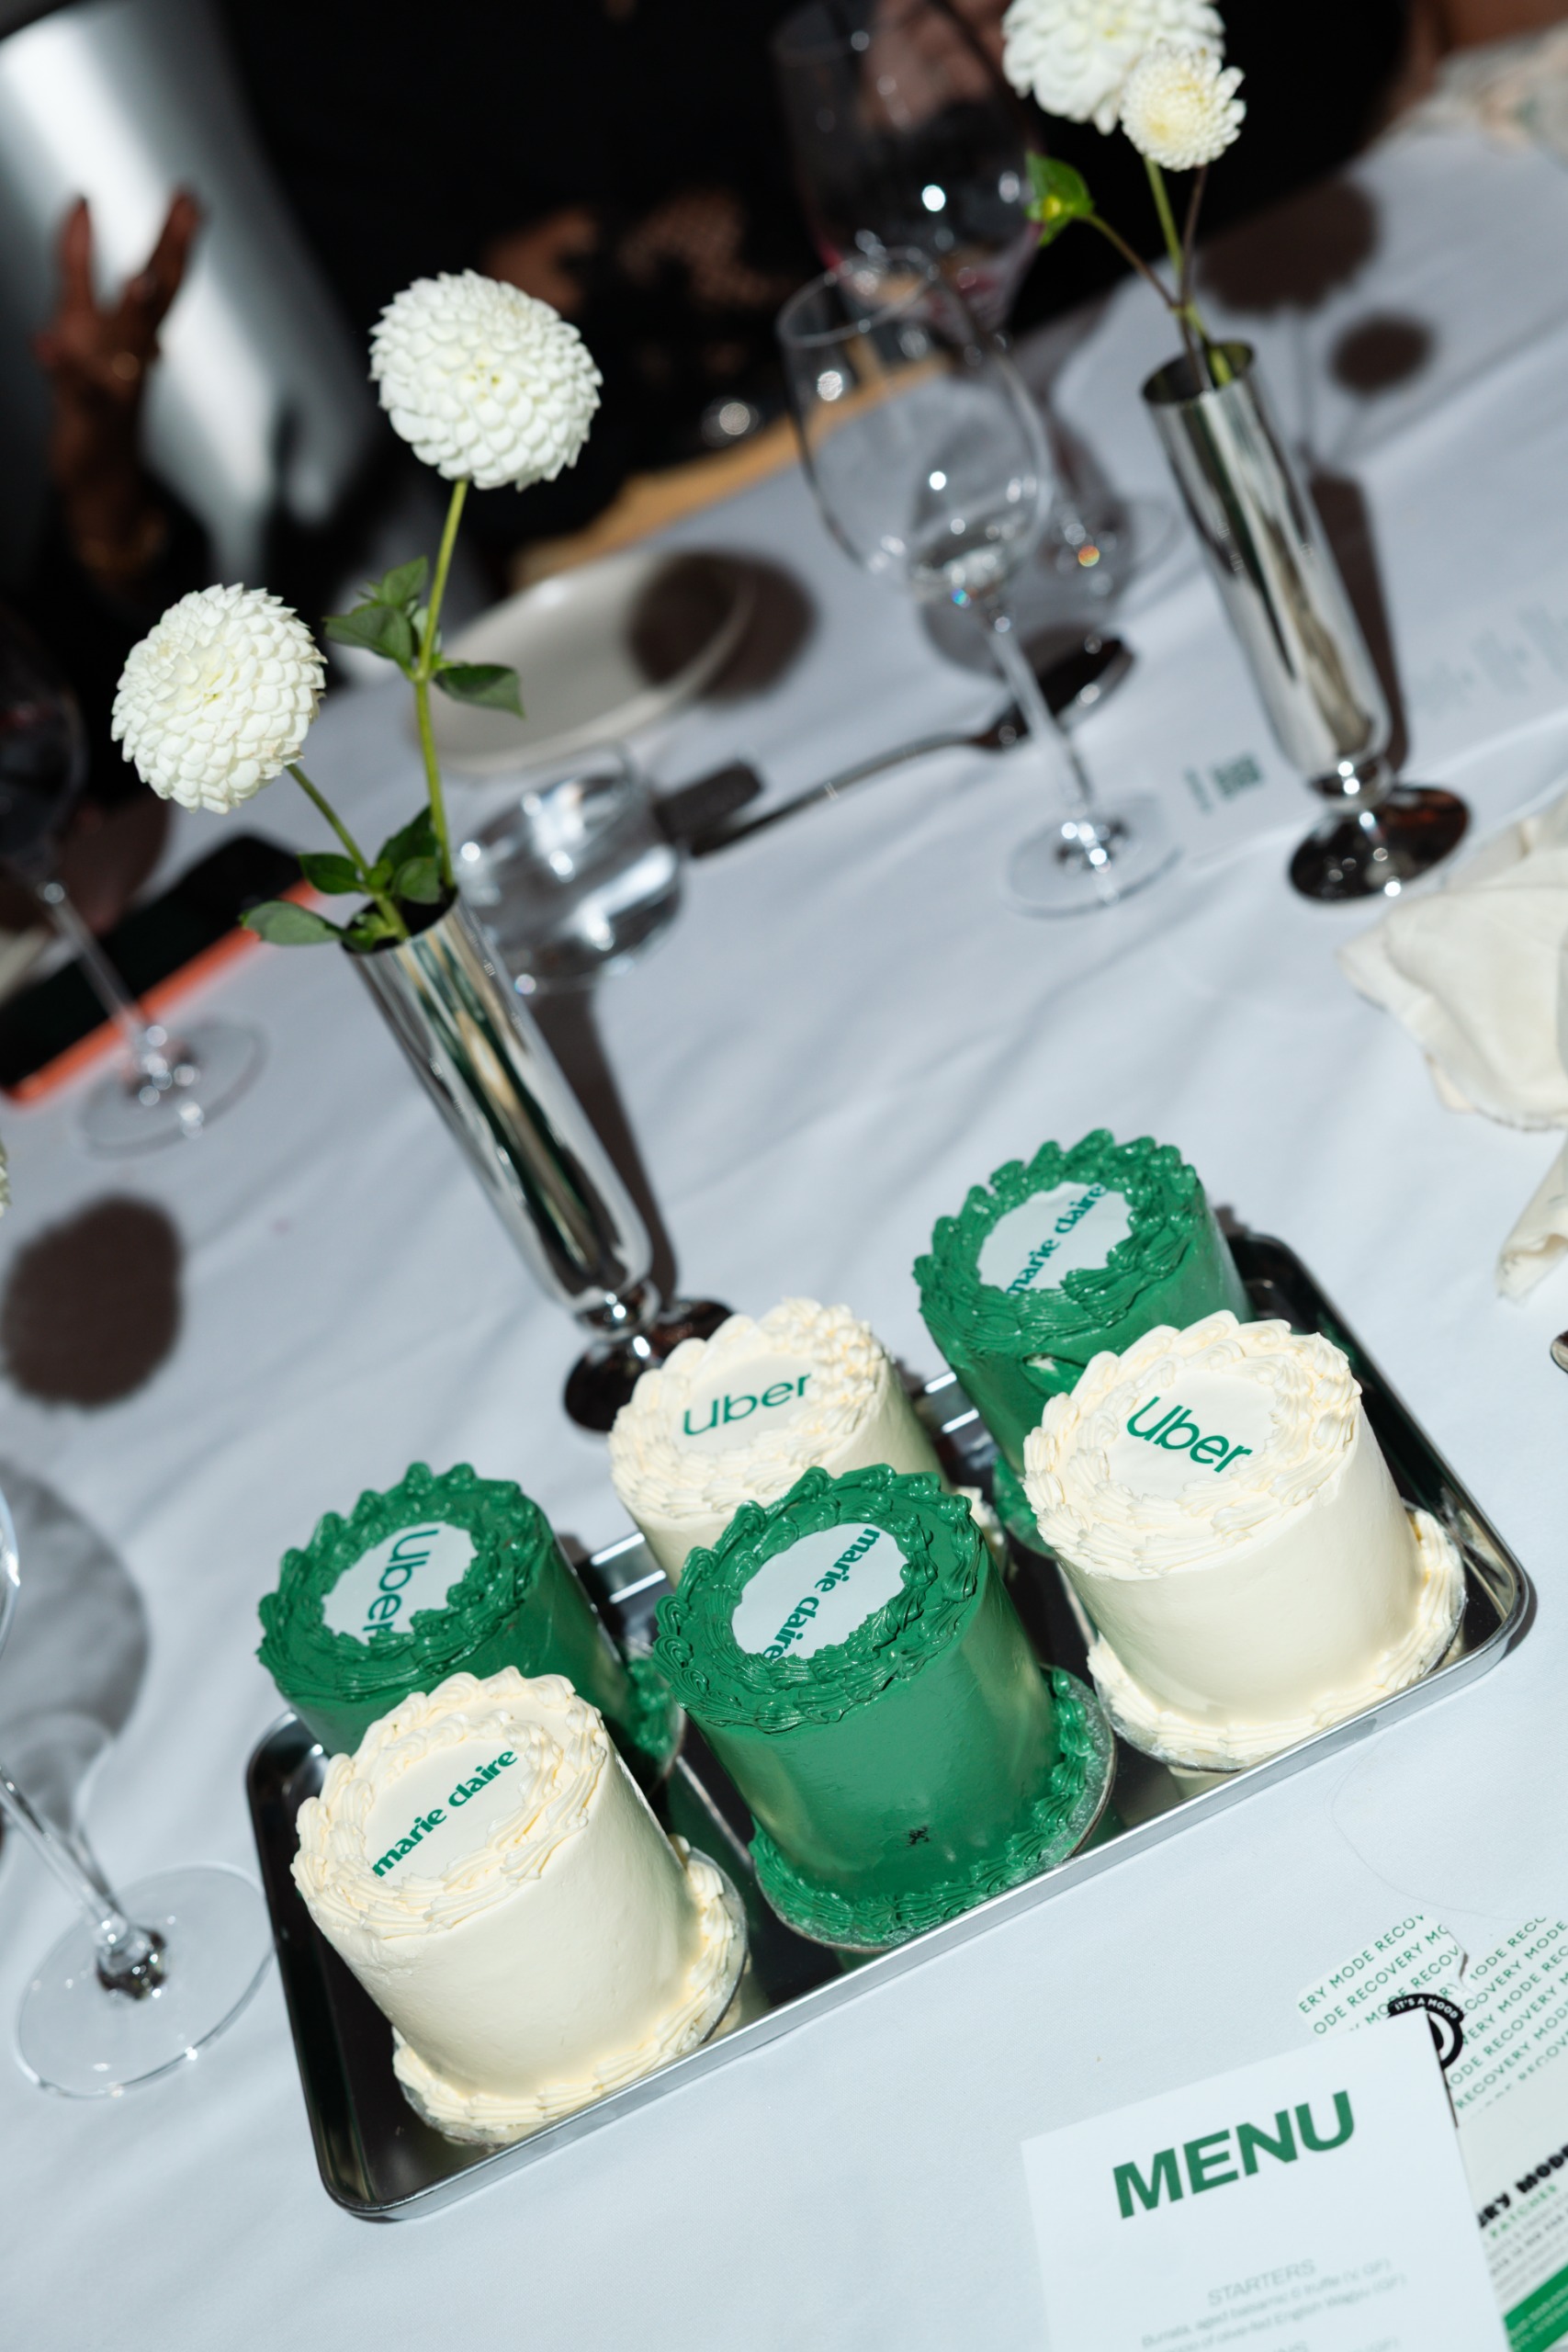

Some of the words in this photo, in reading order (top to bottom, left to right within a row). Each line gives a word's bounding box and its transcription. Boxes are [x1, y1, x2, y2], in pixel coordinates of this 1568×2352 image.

[1008, 1236, 1060, 1295] marie
[1055, 1182, 1108, 1235] claire
[682, 1373, 811, 1436] Uber
[1127, 1396, 1252, 1473] Uber
[363, 1529, 439, 1634] Uber
[815, 1528, 880, 1592] marie
[762, 1596, 819, 1660] claire
[371, 1808, 447, 1877] marie
[448, 1750, 517, 1807] claire
[1329, 1950, 1374, 1989] MODE
[1347, 1942, 1424, 2007] RECOVERY
[1461, 1960, 1522, 2014] COVERY
[1525, 1920, 1568, 1960] MODE
[1497, 1973, 1541, 2014] MODE
[1416, 1996, 1426, 2005] A
[1427, 1998, 1459, 2018] MOOD
[1448, 2056, 1483, 2088] ODE
[1483, 1985, 1557, 2056] RECOVERY
[1455, 2041, 1530, 2109] RECOVERY
[1533, 2001, 1568, 2041] MOD
[1112, 2090, 1355, 2220] MENU
[1208, 2258, 1316, 2308] STARTERS
